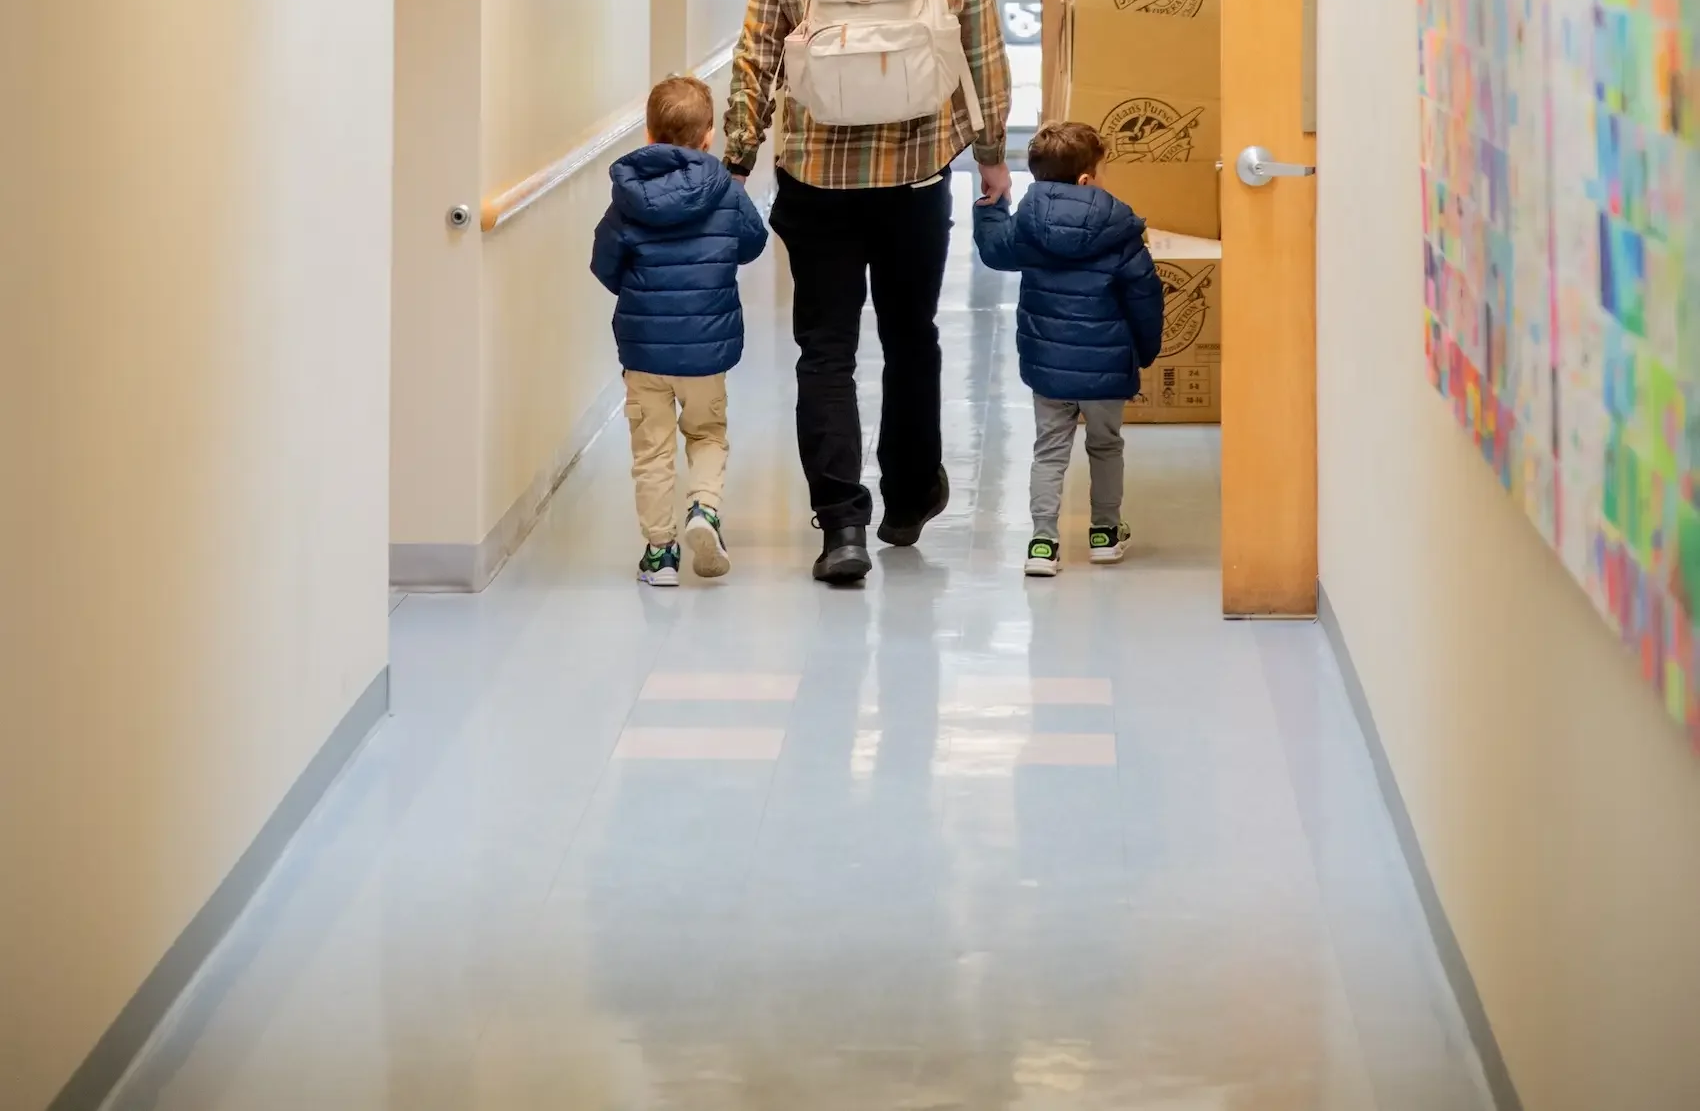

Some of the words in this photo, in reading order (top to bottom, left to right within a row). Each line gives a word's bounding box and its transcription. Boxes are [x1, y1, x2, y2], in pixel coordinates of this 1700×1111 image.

[1143, 100, 1173, 124] Purse
[1163, 303, 1198, 338] ERATION
[1164, 367, 1176, 387] GIRL
